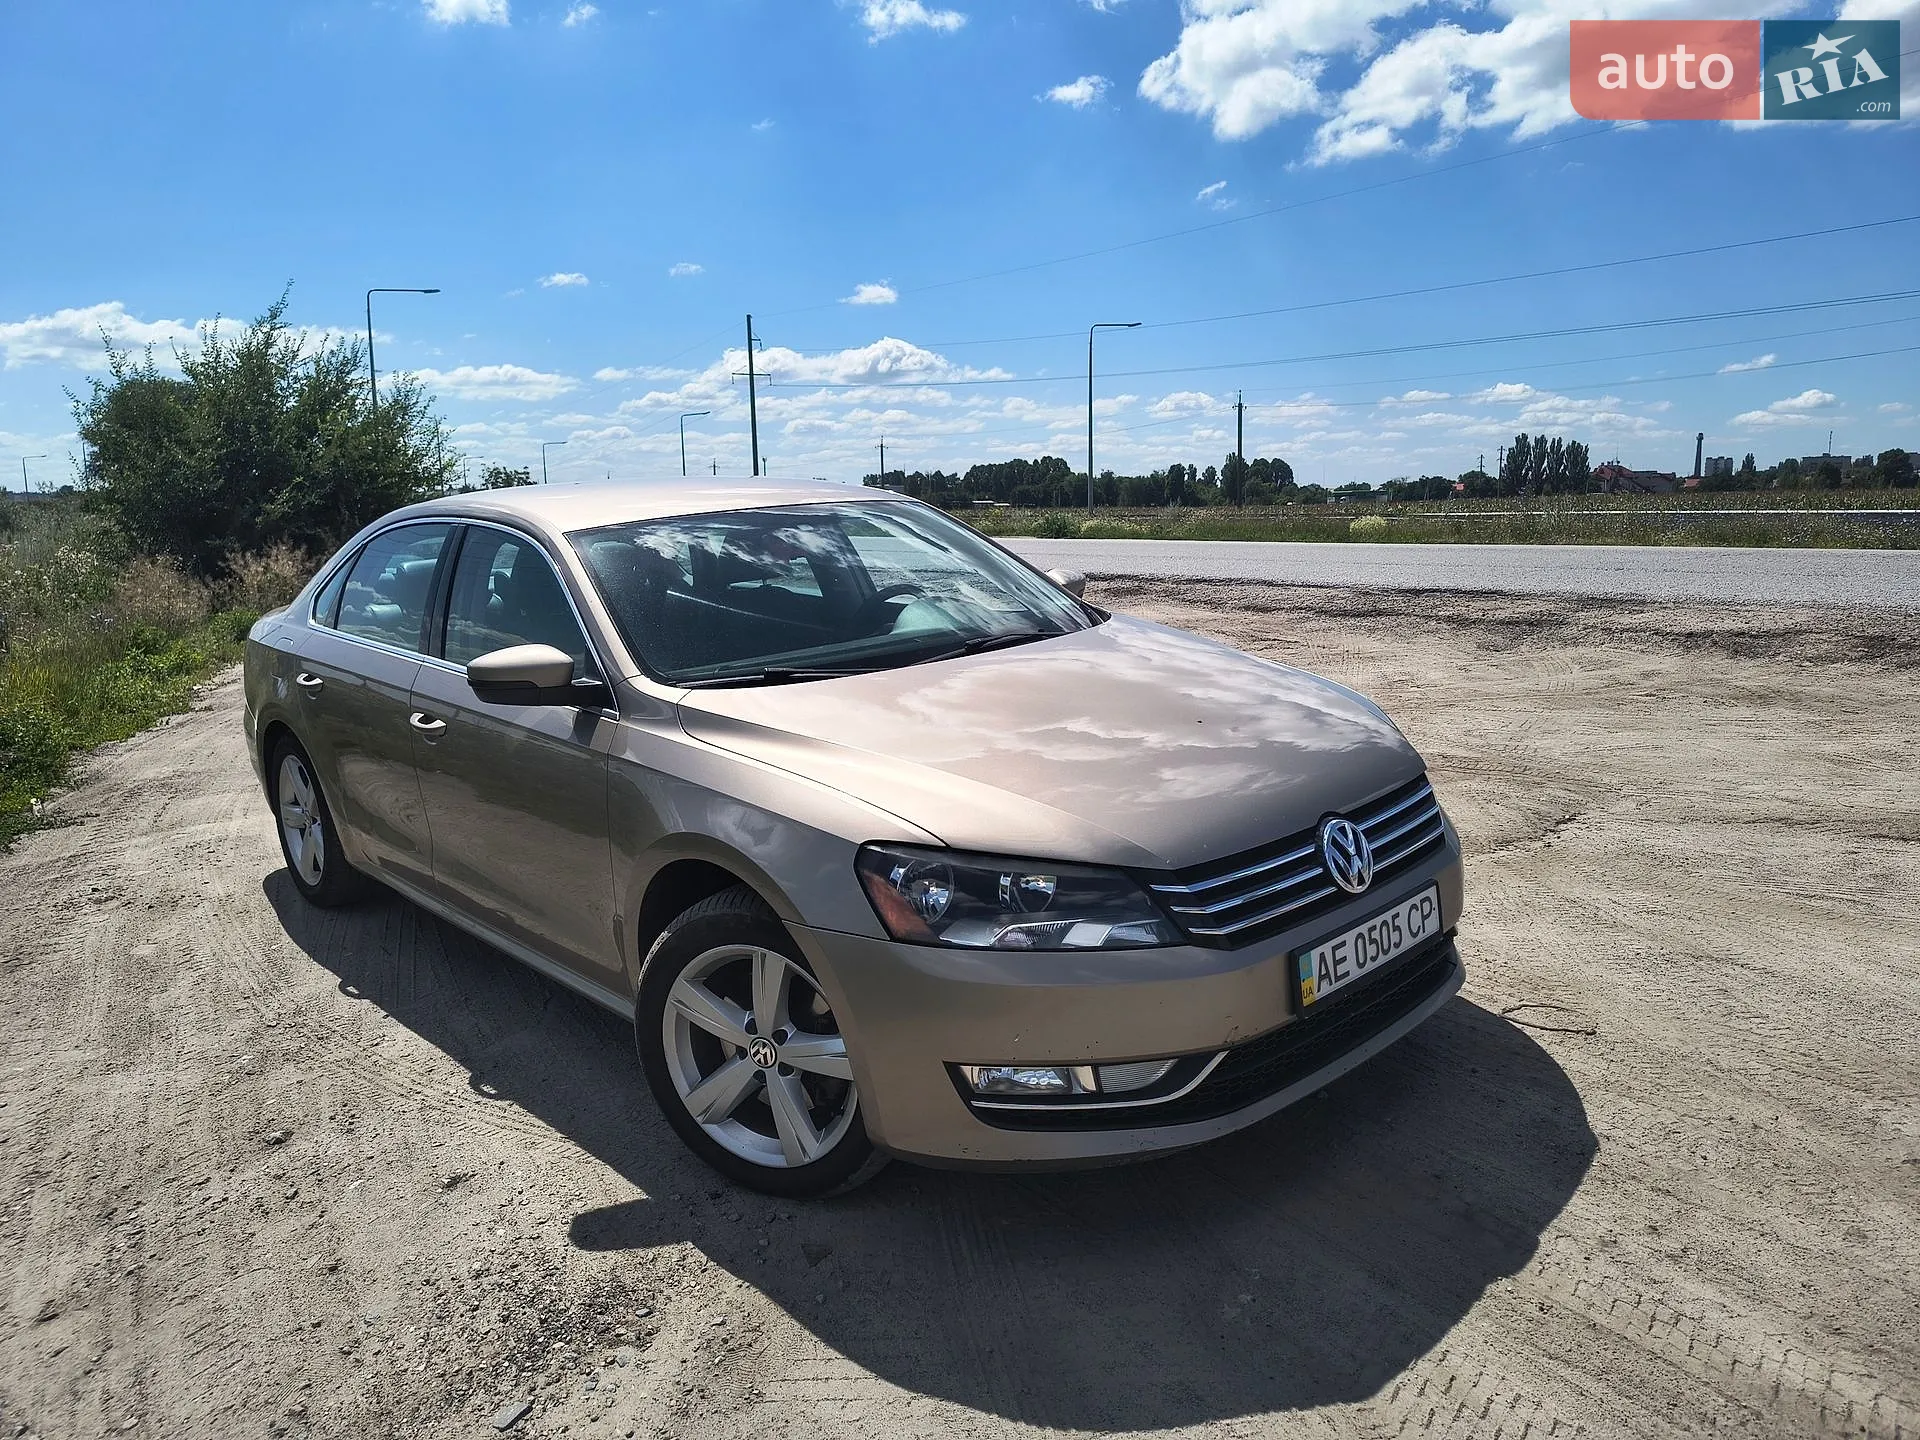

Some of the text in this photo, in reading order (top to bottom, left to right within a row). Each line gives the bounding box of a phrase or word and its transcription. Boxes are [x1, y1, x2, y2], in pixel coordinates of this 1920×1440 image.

[1316, 895, 1434, 994] AE 0505 CP
[1302, 986, 1314, 999] UA
